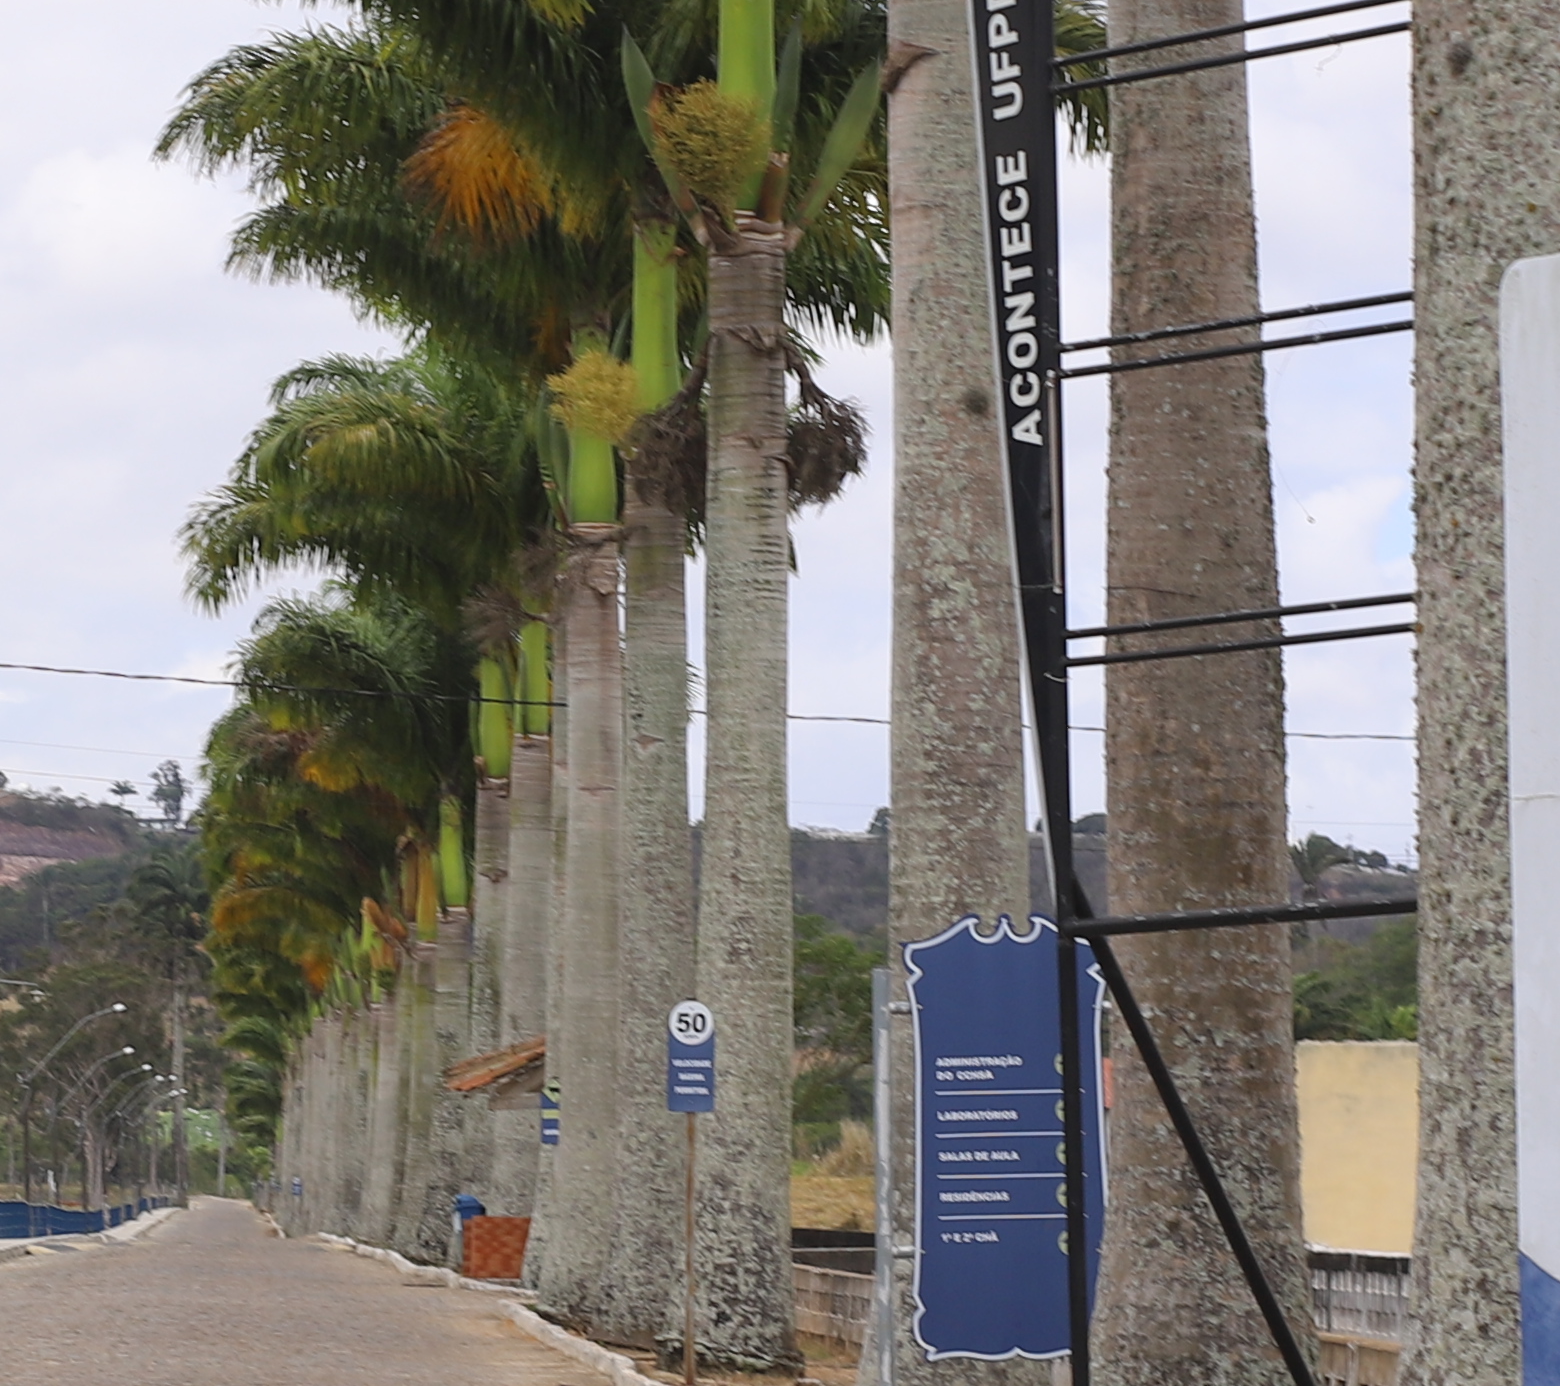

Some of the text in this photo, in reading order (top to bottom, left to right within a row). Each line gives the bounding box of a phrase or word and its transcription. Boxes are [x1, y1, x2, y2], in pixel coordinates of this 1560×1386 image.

[995, 150, 1043, 446] ACONTECE
[676, 1013, 705, 1033] 50
[935, 1054, 1024, 1069] ADMINISTRAÇÃO
